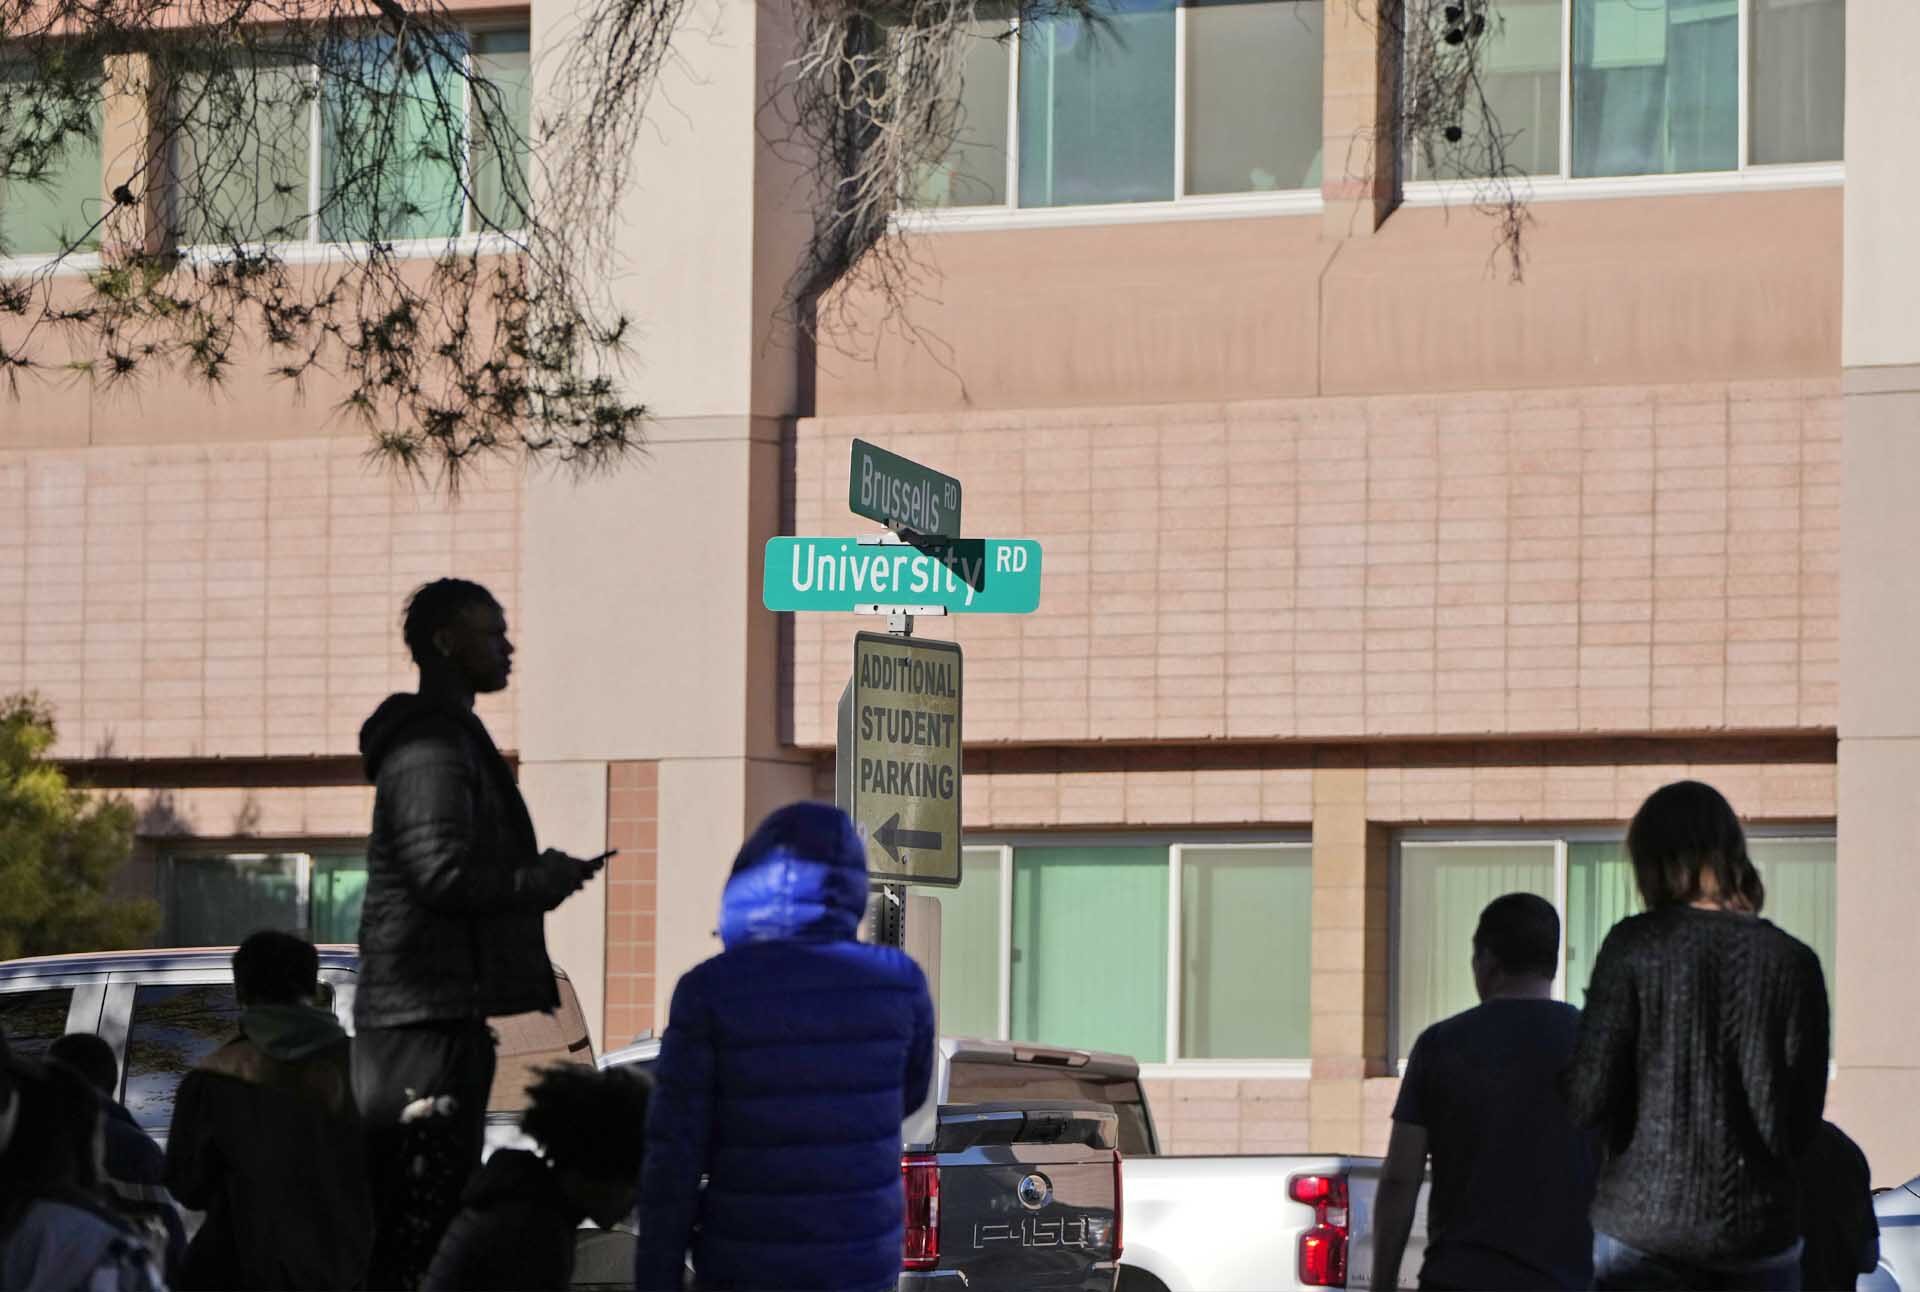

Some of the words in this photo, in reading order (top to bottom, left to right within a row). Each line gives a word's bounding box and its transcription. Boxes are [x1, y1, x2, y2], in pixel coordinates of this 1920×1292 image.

[861, 454, 940, 533] Brussells
[944, 482, 957, 511] RD
[792, 544, 982, 606] University
[996, 546, 1027, 572] RD
[861, 654, 956, 698] ADDITIONAL
[861, 706, 955, 748] STUDENT
[861, 758, 953, 799] PARKING
